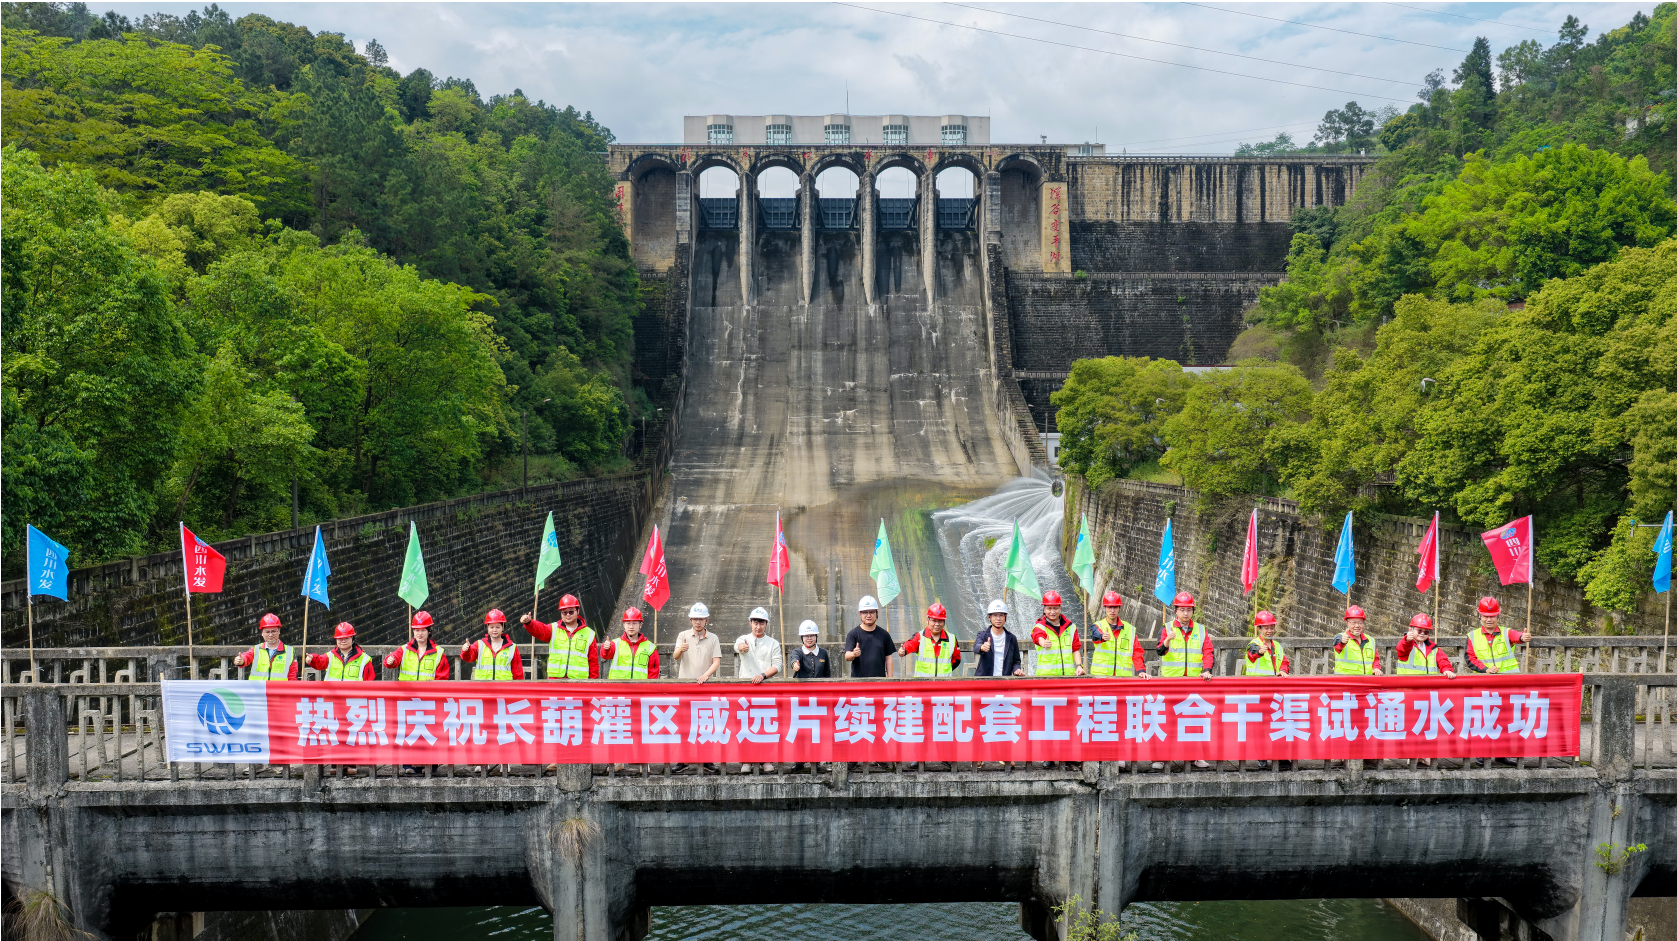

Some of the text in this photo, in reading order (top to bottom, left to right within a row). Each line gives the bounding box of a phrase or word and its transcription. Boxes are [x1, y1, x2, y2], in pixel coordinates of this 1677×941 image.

[38, 547, 57, 590] 四川水发
[193, 545, 208, 588] 四川水发
[294, 691, 1550, 746] 热烈庆祝长葫灌区威远片续建配套工程联合干渠试通水成功
[186, 742, 263, 755] SWDG
